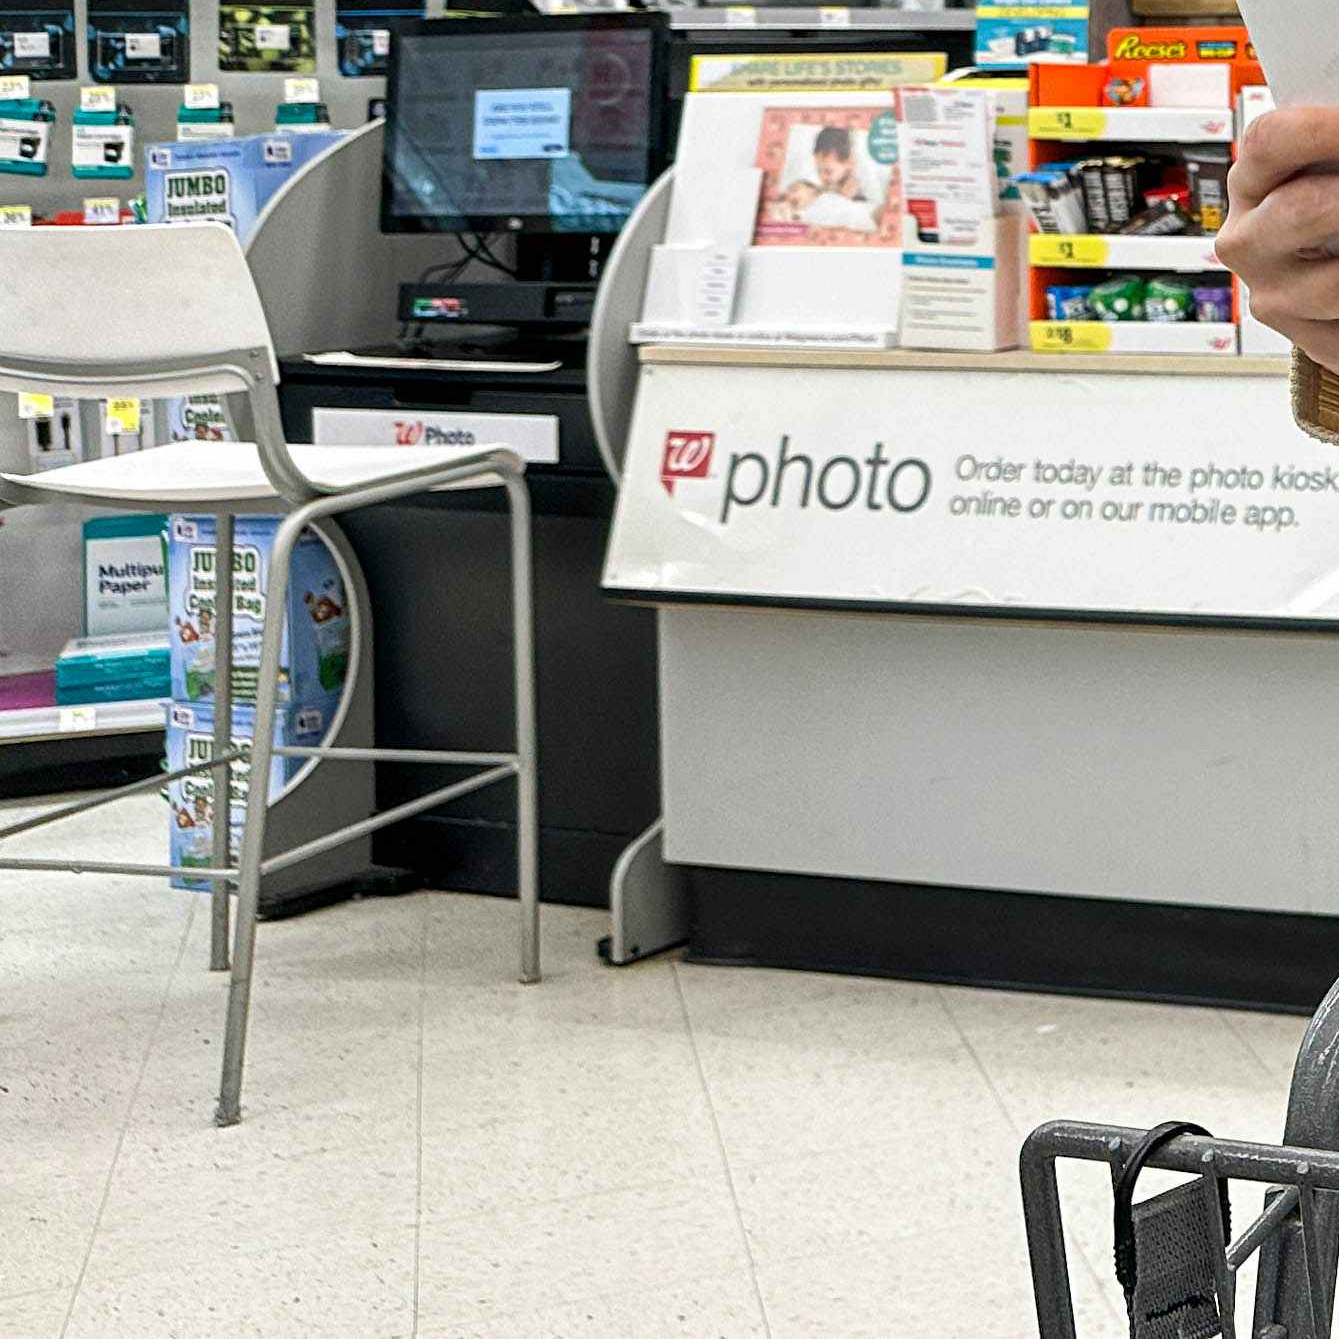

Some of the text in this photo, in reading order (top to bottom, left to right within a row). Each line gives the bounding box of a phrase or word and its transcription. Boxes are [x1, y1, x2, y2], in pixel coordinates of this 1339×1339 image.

[1114, 34, 1187, 59] Reese's
[167, 174, 227, 199] JUMBO
[167, 199, 227, 217] Insulated
[425, 426, 476, 446] Photo
[719, 434, 933, 524] photo
[955, 453, 1026, 482] Order
[1032, 458, 1102, 491] today
[1109, 462, 1135, 487] at
[1142, 460, 1182, 489] the
[1190, 462, 1264, 494] photo
[949, 491, 1300, 532] online or on our mobile app.
[99, 578, 151, 597] Paper
